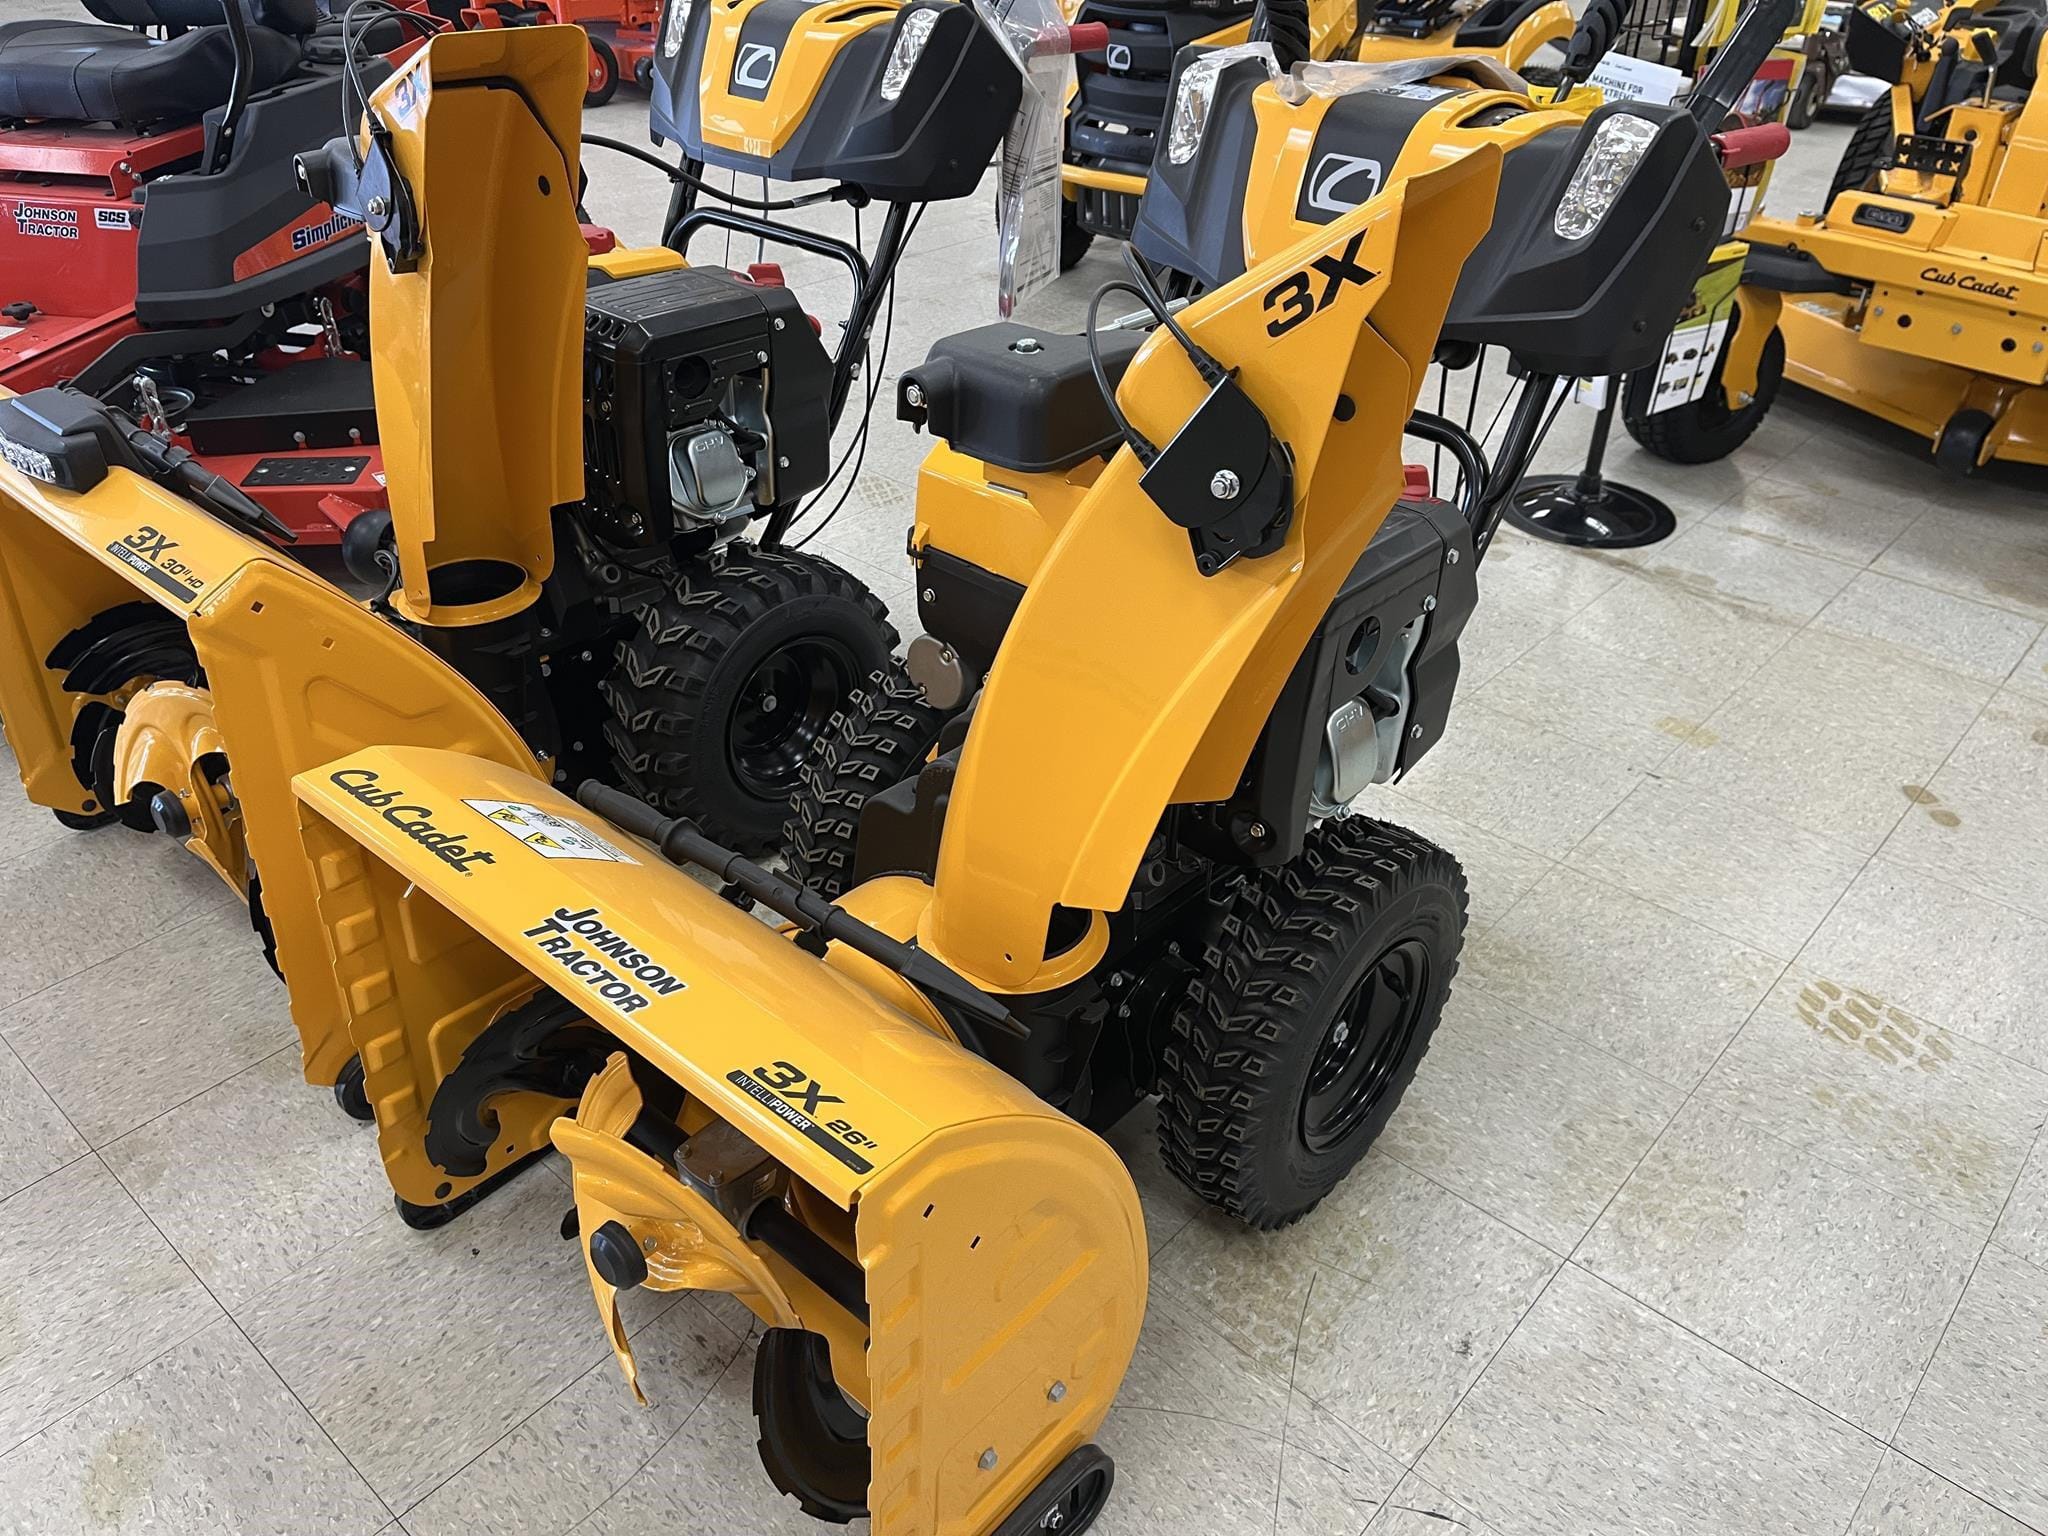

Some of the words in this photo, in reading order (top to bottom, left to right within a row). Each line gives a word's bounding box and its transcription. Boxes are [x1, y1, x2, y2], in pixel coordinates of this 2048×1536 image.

[1592, 73, 1628, 91] MACHINE
[1627, 83, 1644, 95] FOR
[14, 201, 77, 222] JOHNSON
[17, 219, 78, 238] TRACTOR
[98, 210, 127, 223] SCS
[292, 213, 364, 250] Simplic
[1263, 227, 1378, 338] 3X
[1920, 267, 1957, 286] Cub
[1957, 275, 2019, 300] Cadet
[123, 525, 180, 562] 3X
[184, 575, 205, 589] HD
[330, 769, 404, 808] Cub
[382, 805, 497, 874] Cadet
[523, 917, 649, 1014] TRACTOR
[554, 907, 687, 996] JOHNSON
[735, 1074, 812, 1131] INTELLIPOWER
[752, 1060, 846, 1117] 3X
[825, 1118, 879, 1150] 26"
